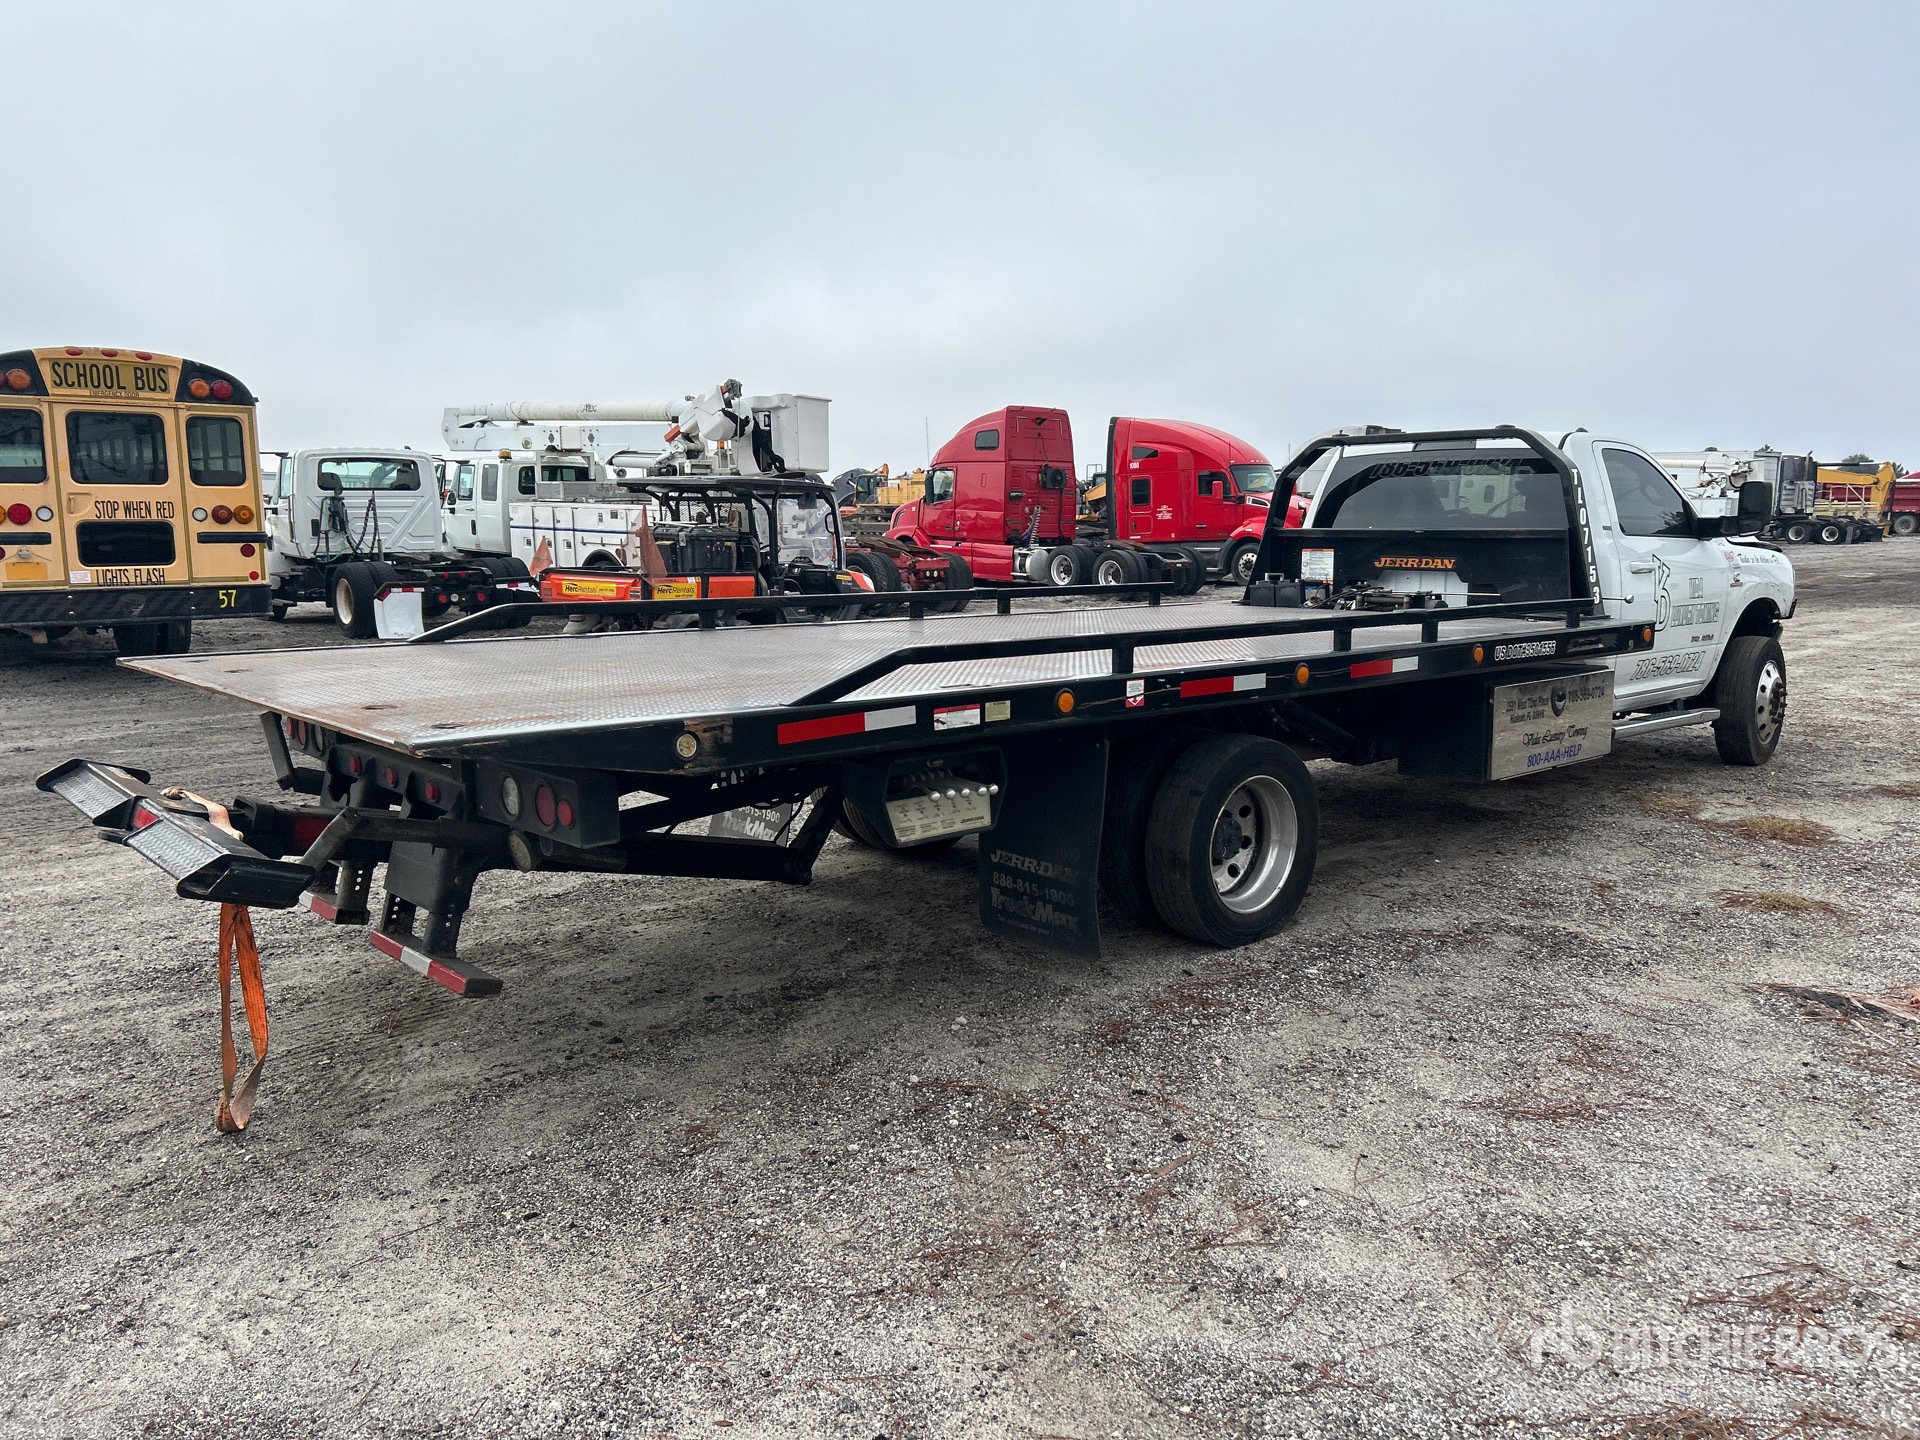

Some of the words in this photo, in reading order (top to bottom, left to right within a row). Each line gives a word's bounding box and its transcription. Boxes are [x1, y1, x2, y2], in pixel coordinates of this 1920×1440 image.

[51, 361, 126, 390] SCHOOL
[133, 366, 168, 393] BUS
[94, 500, 119, 519] STOP
[122, 500, 151, 519] WHEN
[156, 501, 174, 519] RED
[96, 569, 130, 587] LIGHTS
[134, 568, 166, 586] FLASH
[218, 589, 237, 608] 57
[657, 585, 696, 595] HercRentals
[1494, 645, 1507, 661] US
[1630, 651, 1706, 681] 786-569-0724
[1527, 744, 1582, 768] 800-AAA-HELP
